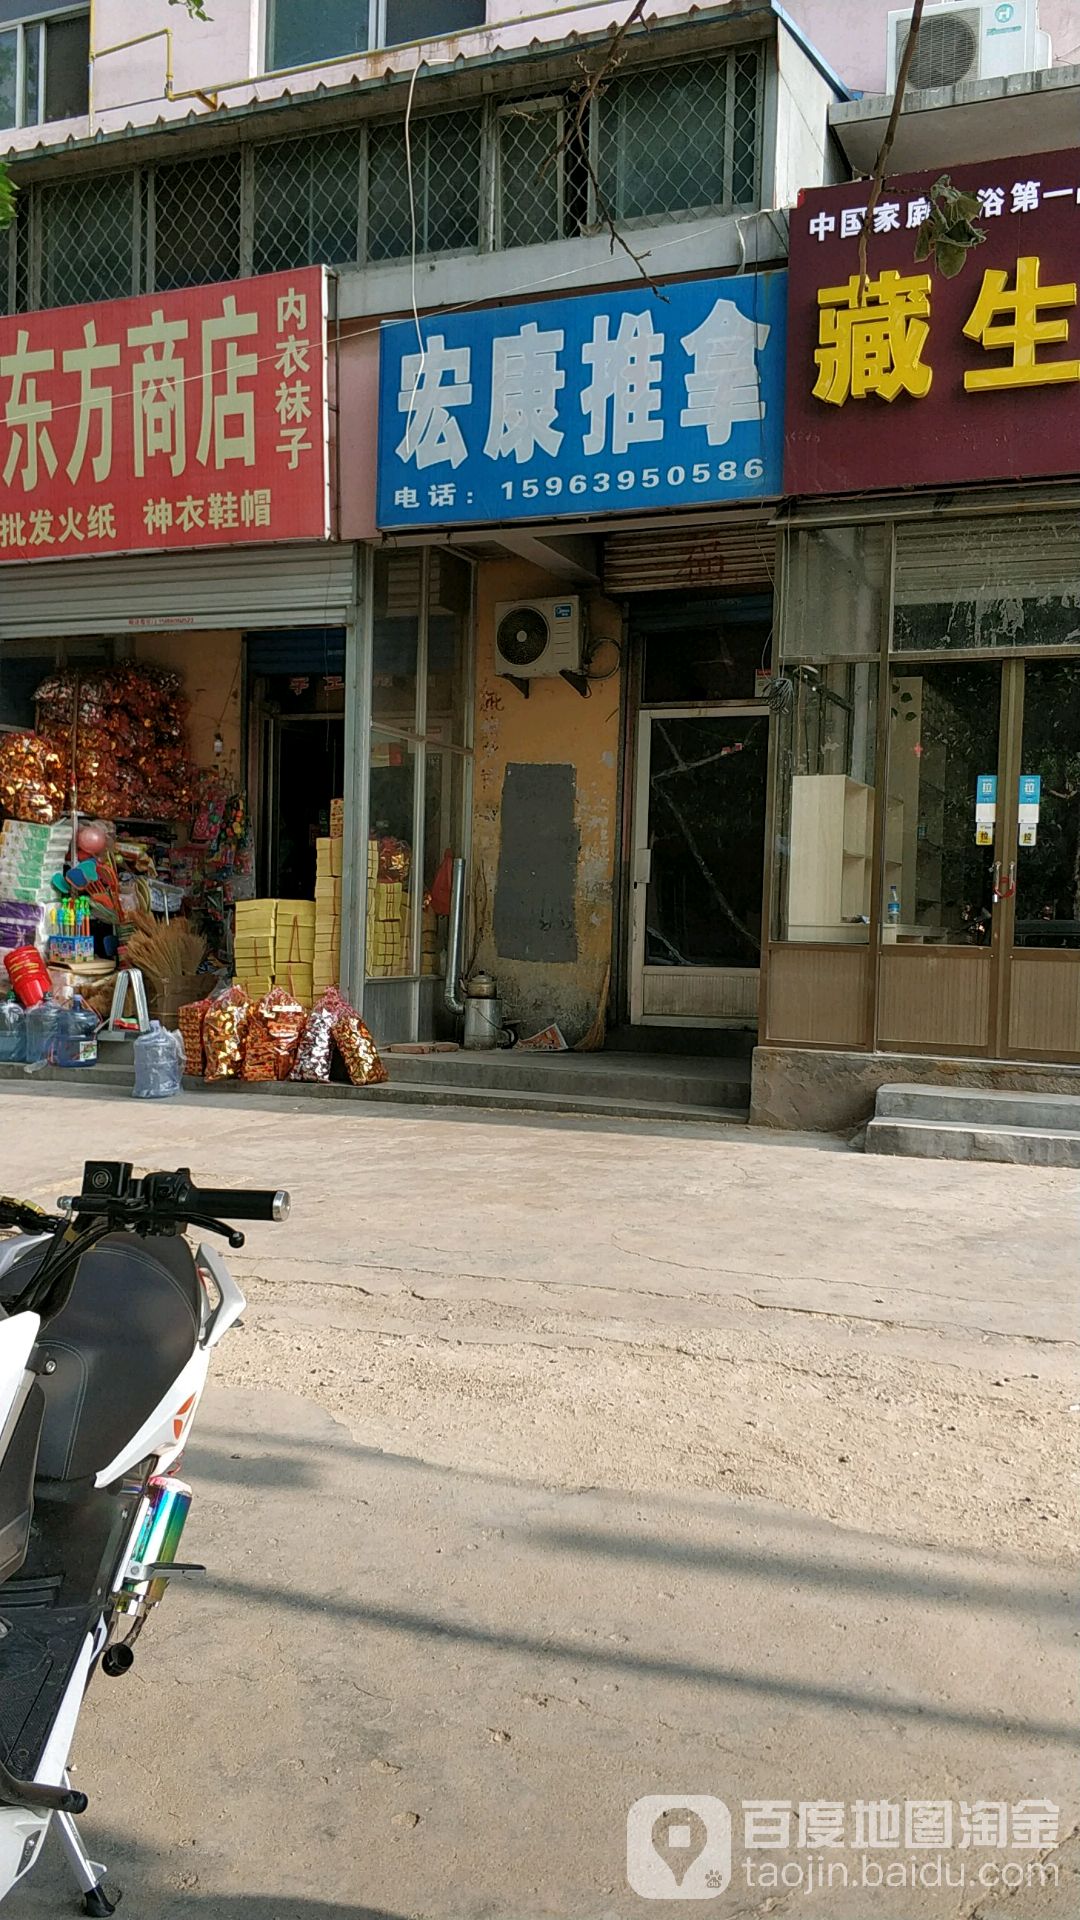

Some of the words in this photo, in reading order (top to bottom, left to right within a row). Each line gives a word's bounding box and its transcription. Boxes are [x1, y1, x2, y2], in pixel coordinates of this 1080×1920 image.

[808, 181, 1080, 241] 中国家庭浴第一
[0, 296, 258, 492] 东方商店
[275, 288, 312, 470] 内衣袜子
[395, 299, 771, 470] 宏康推拿
[812, 256, 1080, 407] 藏生
[0, 503, 117, 547] 批发火纸
[143, 489, 271, 536] 神衣鞋帽
[501, 458, 764, 500] 15963950586
